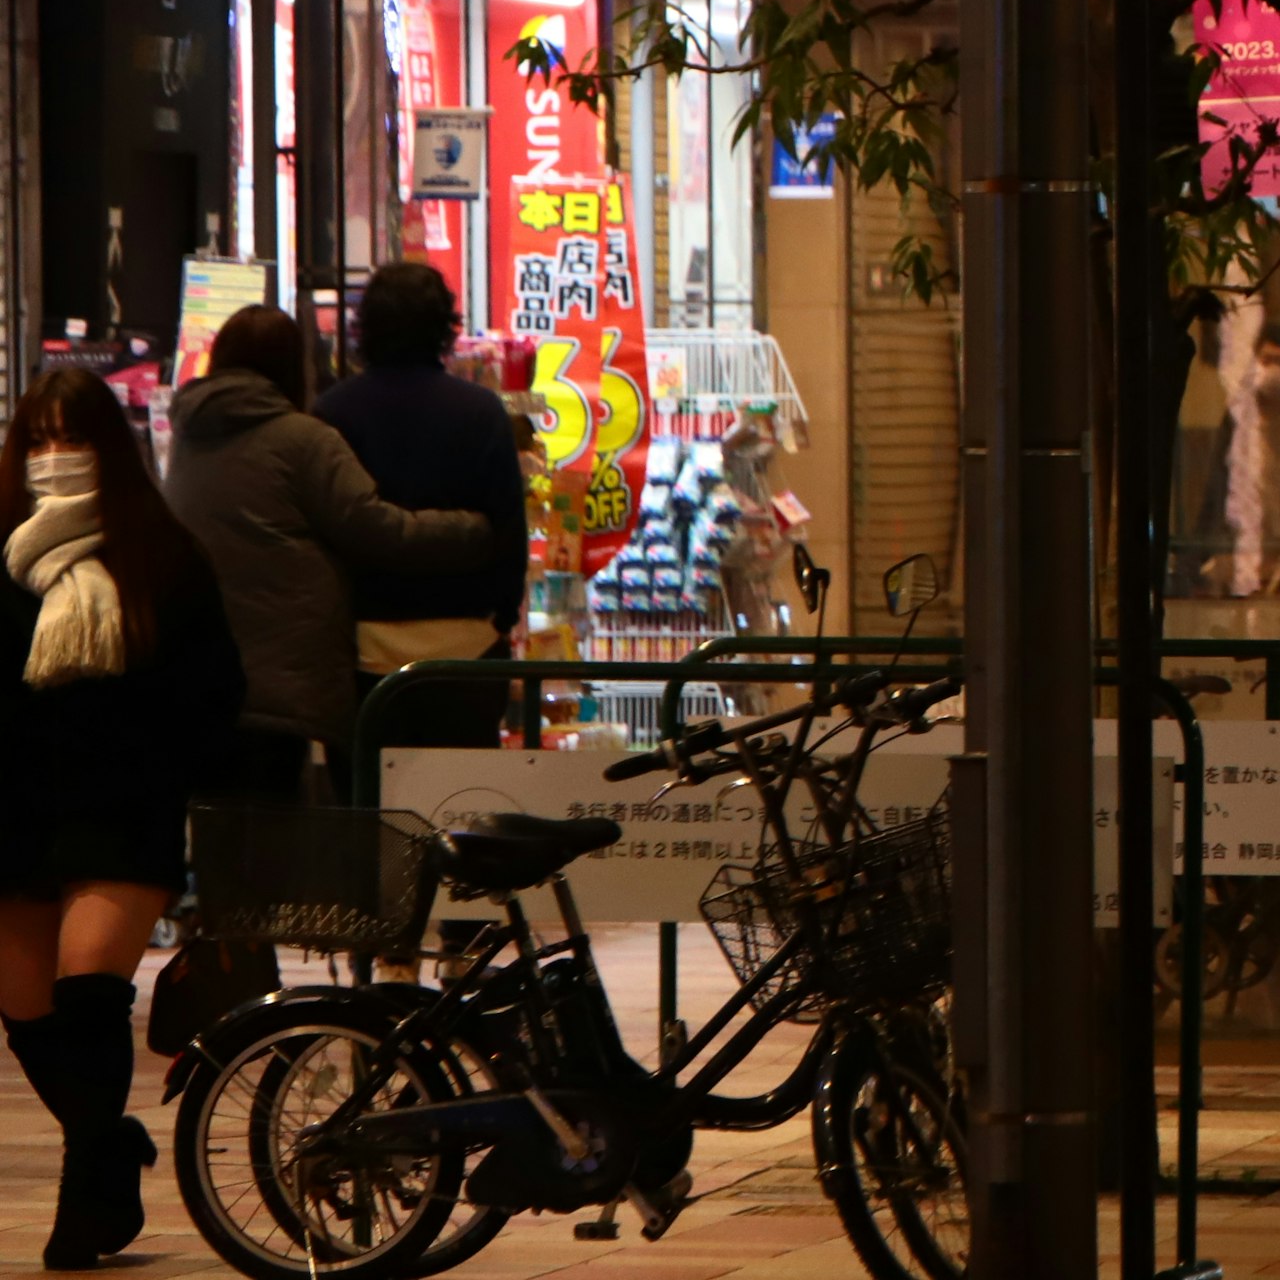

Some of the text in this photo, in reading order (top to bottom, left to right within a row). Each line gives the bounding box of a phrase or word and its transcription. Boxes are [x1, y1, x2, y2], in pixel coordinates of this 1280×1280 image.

[518, 190, 599, 234] 本日
[515, 257, 552, 331] 商品
[556, 239, 594, 317] 店内
[584, 490, 627, 531] OFF
